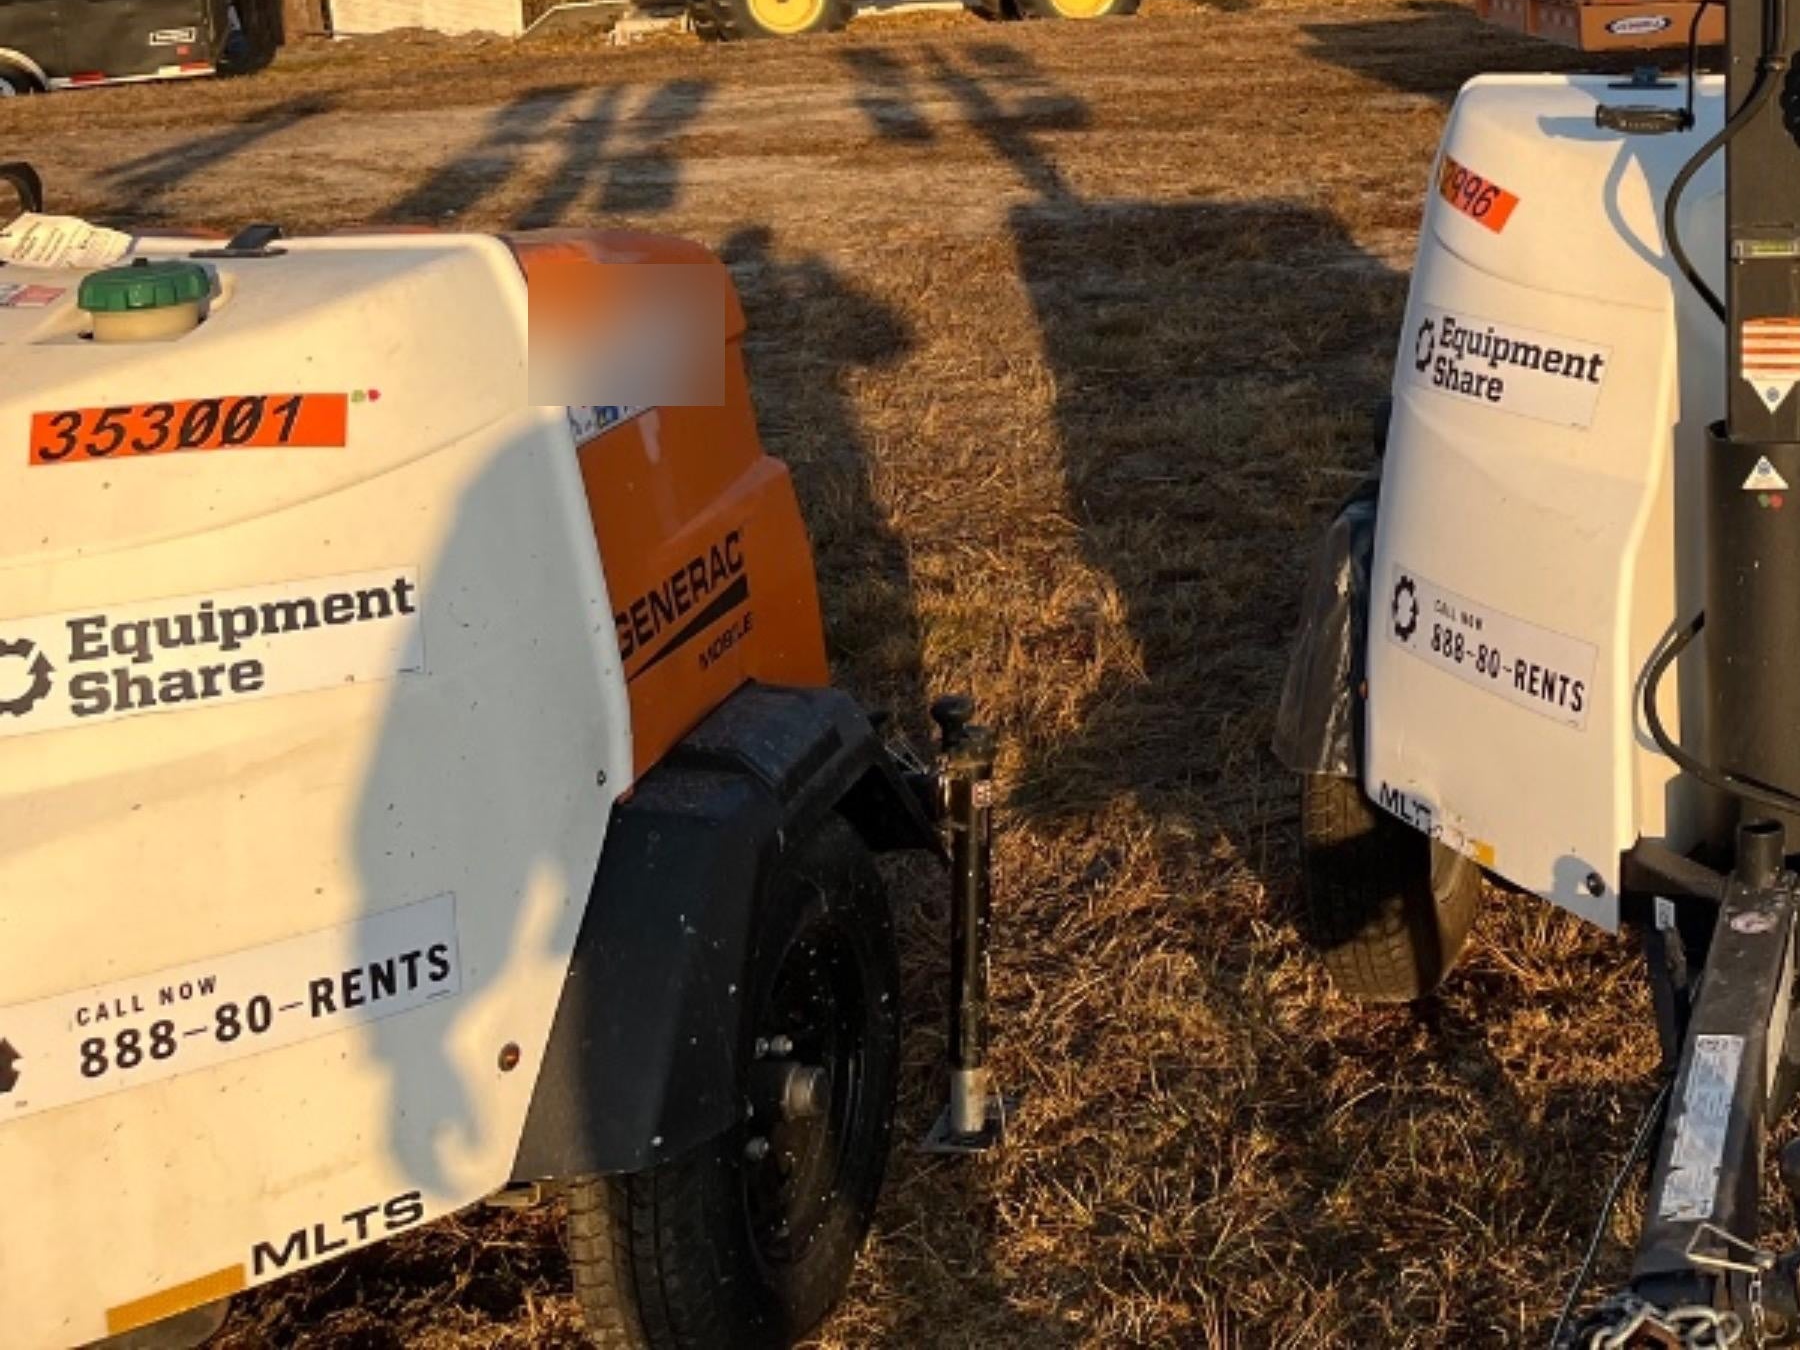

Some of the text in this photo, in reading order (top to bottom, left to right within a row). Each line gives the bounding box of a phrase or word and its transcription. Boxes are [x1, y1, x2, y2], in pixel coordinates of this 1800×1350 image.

[1432, 355, 1504, 402] Share
[1438, 316, 1605, 384] Equipment
[38, 395, 304, 462] 353001
[66, 576, 416, 662] Equipment
[615, 529, 744, 661] GENERAC
[69, 657, 265, 718] Share
[1430, 623, 1586, 712] 888-80-RENTS
[75, 974, 218, 1027] CALL NOW
[79, 943, 452, 1079] 888-80-RENTS
[251, 1191, 425, 1277] MLTS
